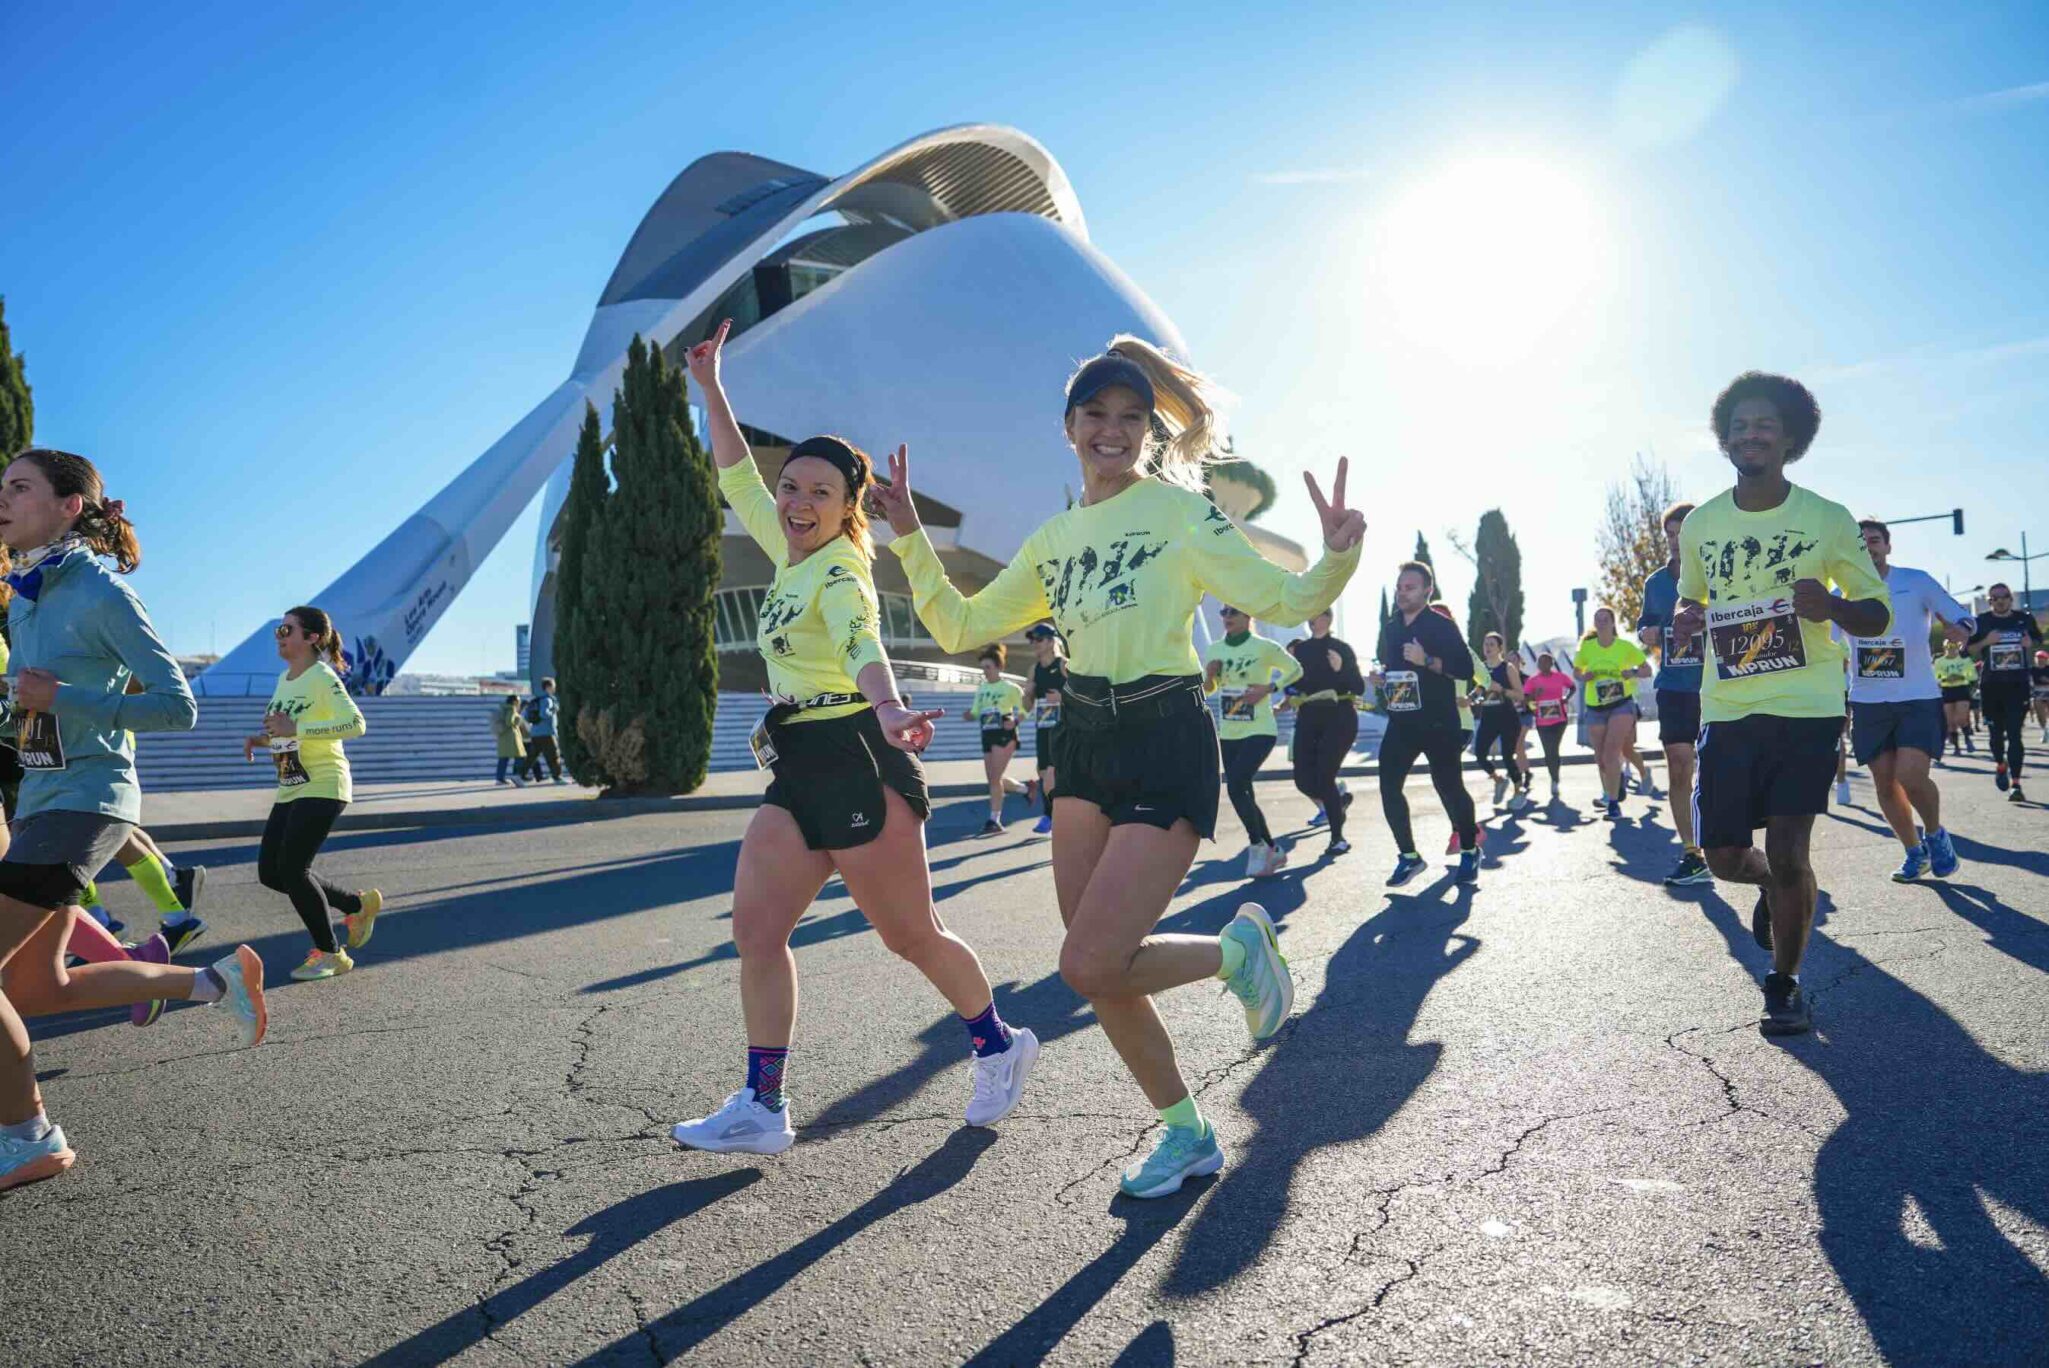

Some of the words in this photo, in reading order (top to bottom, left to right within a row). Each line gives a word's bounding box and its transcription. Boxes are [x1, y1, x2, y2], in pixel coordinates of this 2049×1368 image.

[1213, 523, 1235, 536] Iberc
[1711, 605, 1764, 622] Ibercaja
[1858, 639, 1887, 648] Ibercaja
[1727, 655, 1799, 677] KIPRUN
[305, 726, 330, 736] more
[332, 722, 353, 732] runs
